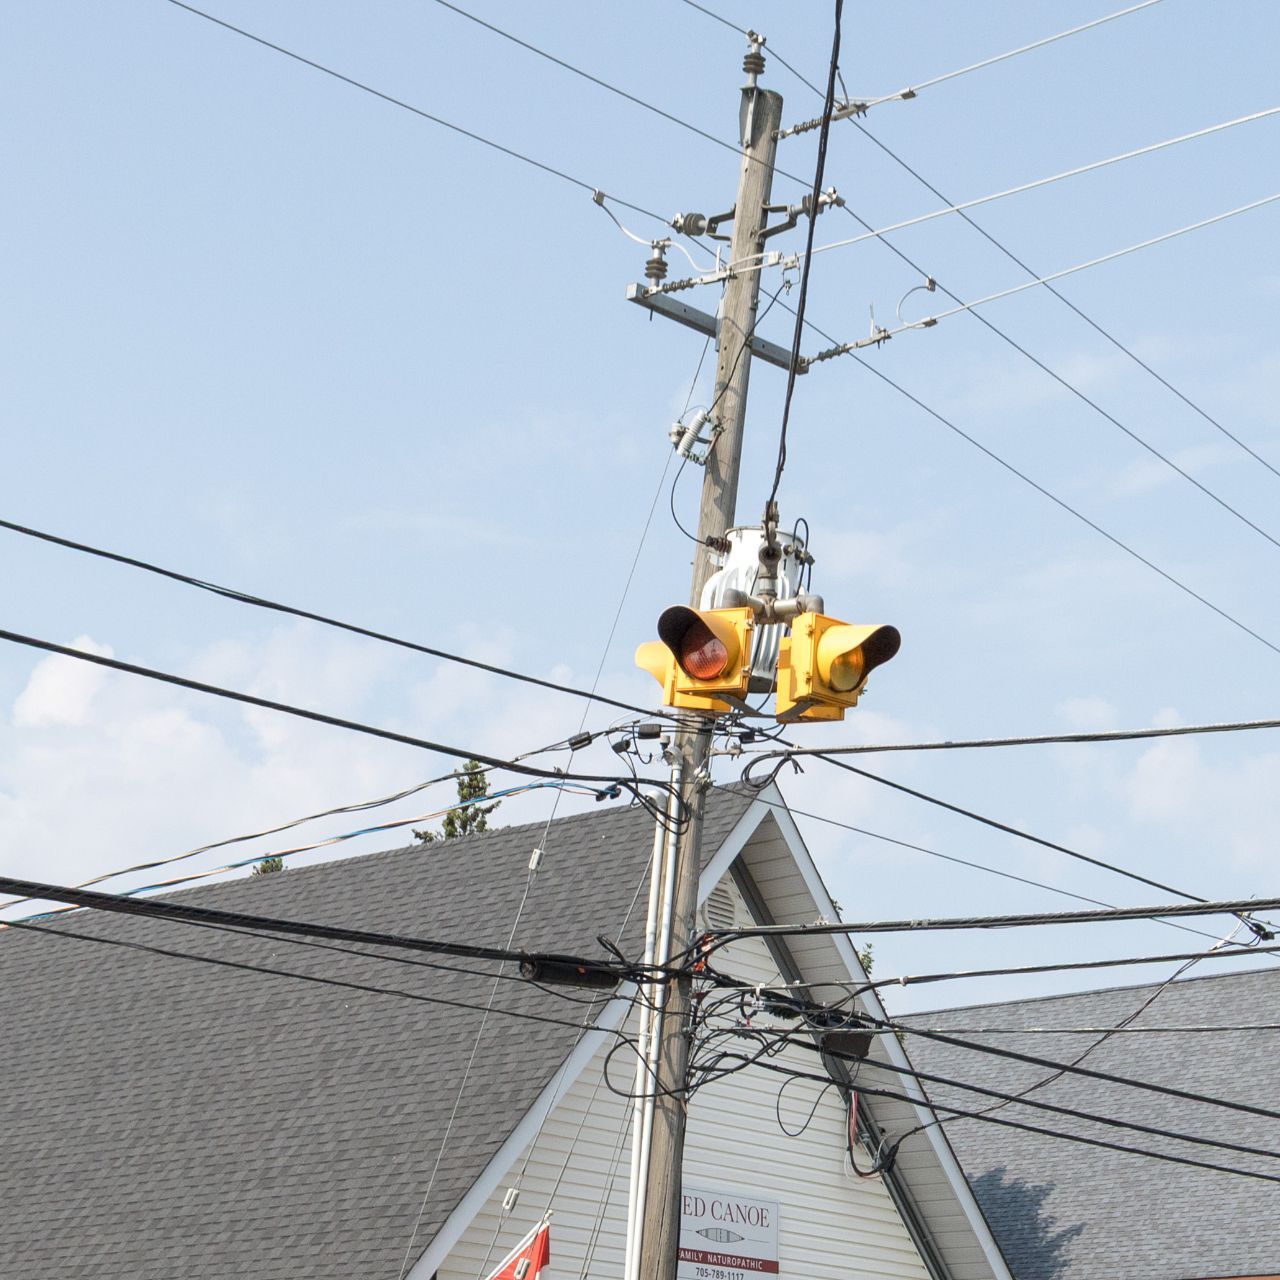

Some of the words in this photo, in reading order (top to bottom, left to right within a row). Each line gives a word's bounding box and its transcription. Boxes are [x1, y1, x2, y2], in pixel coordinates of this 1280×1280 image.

[682, 1195, 706, 1218] ED
[711, 1200, 770, 1228] CANOE
[679, 1250, 703, 1262] AMILY
[707, 1254, 763, 1270] NATUROPATHIC
